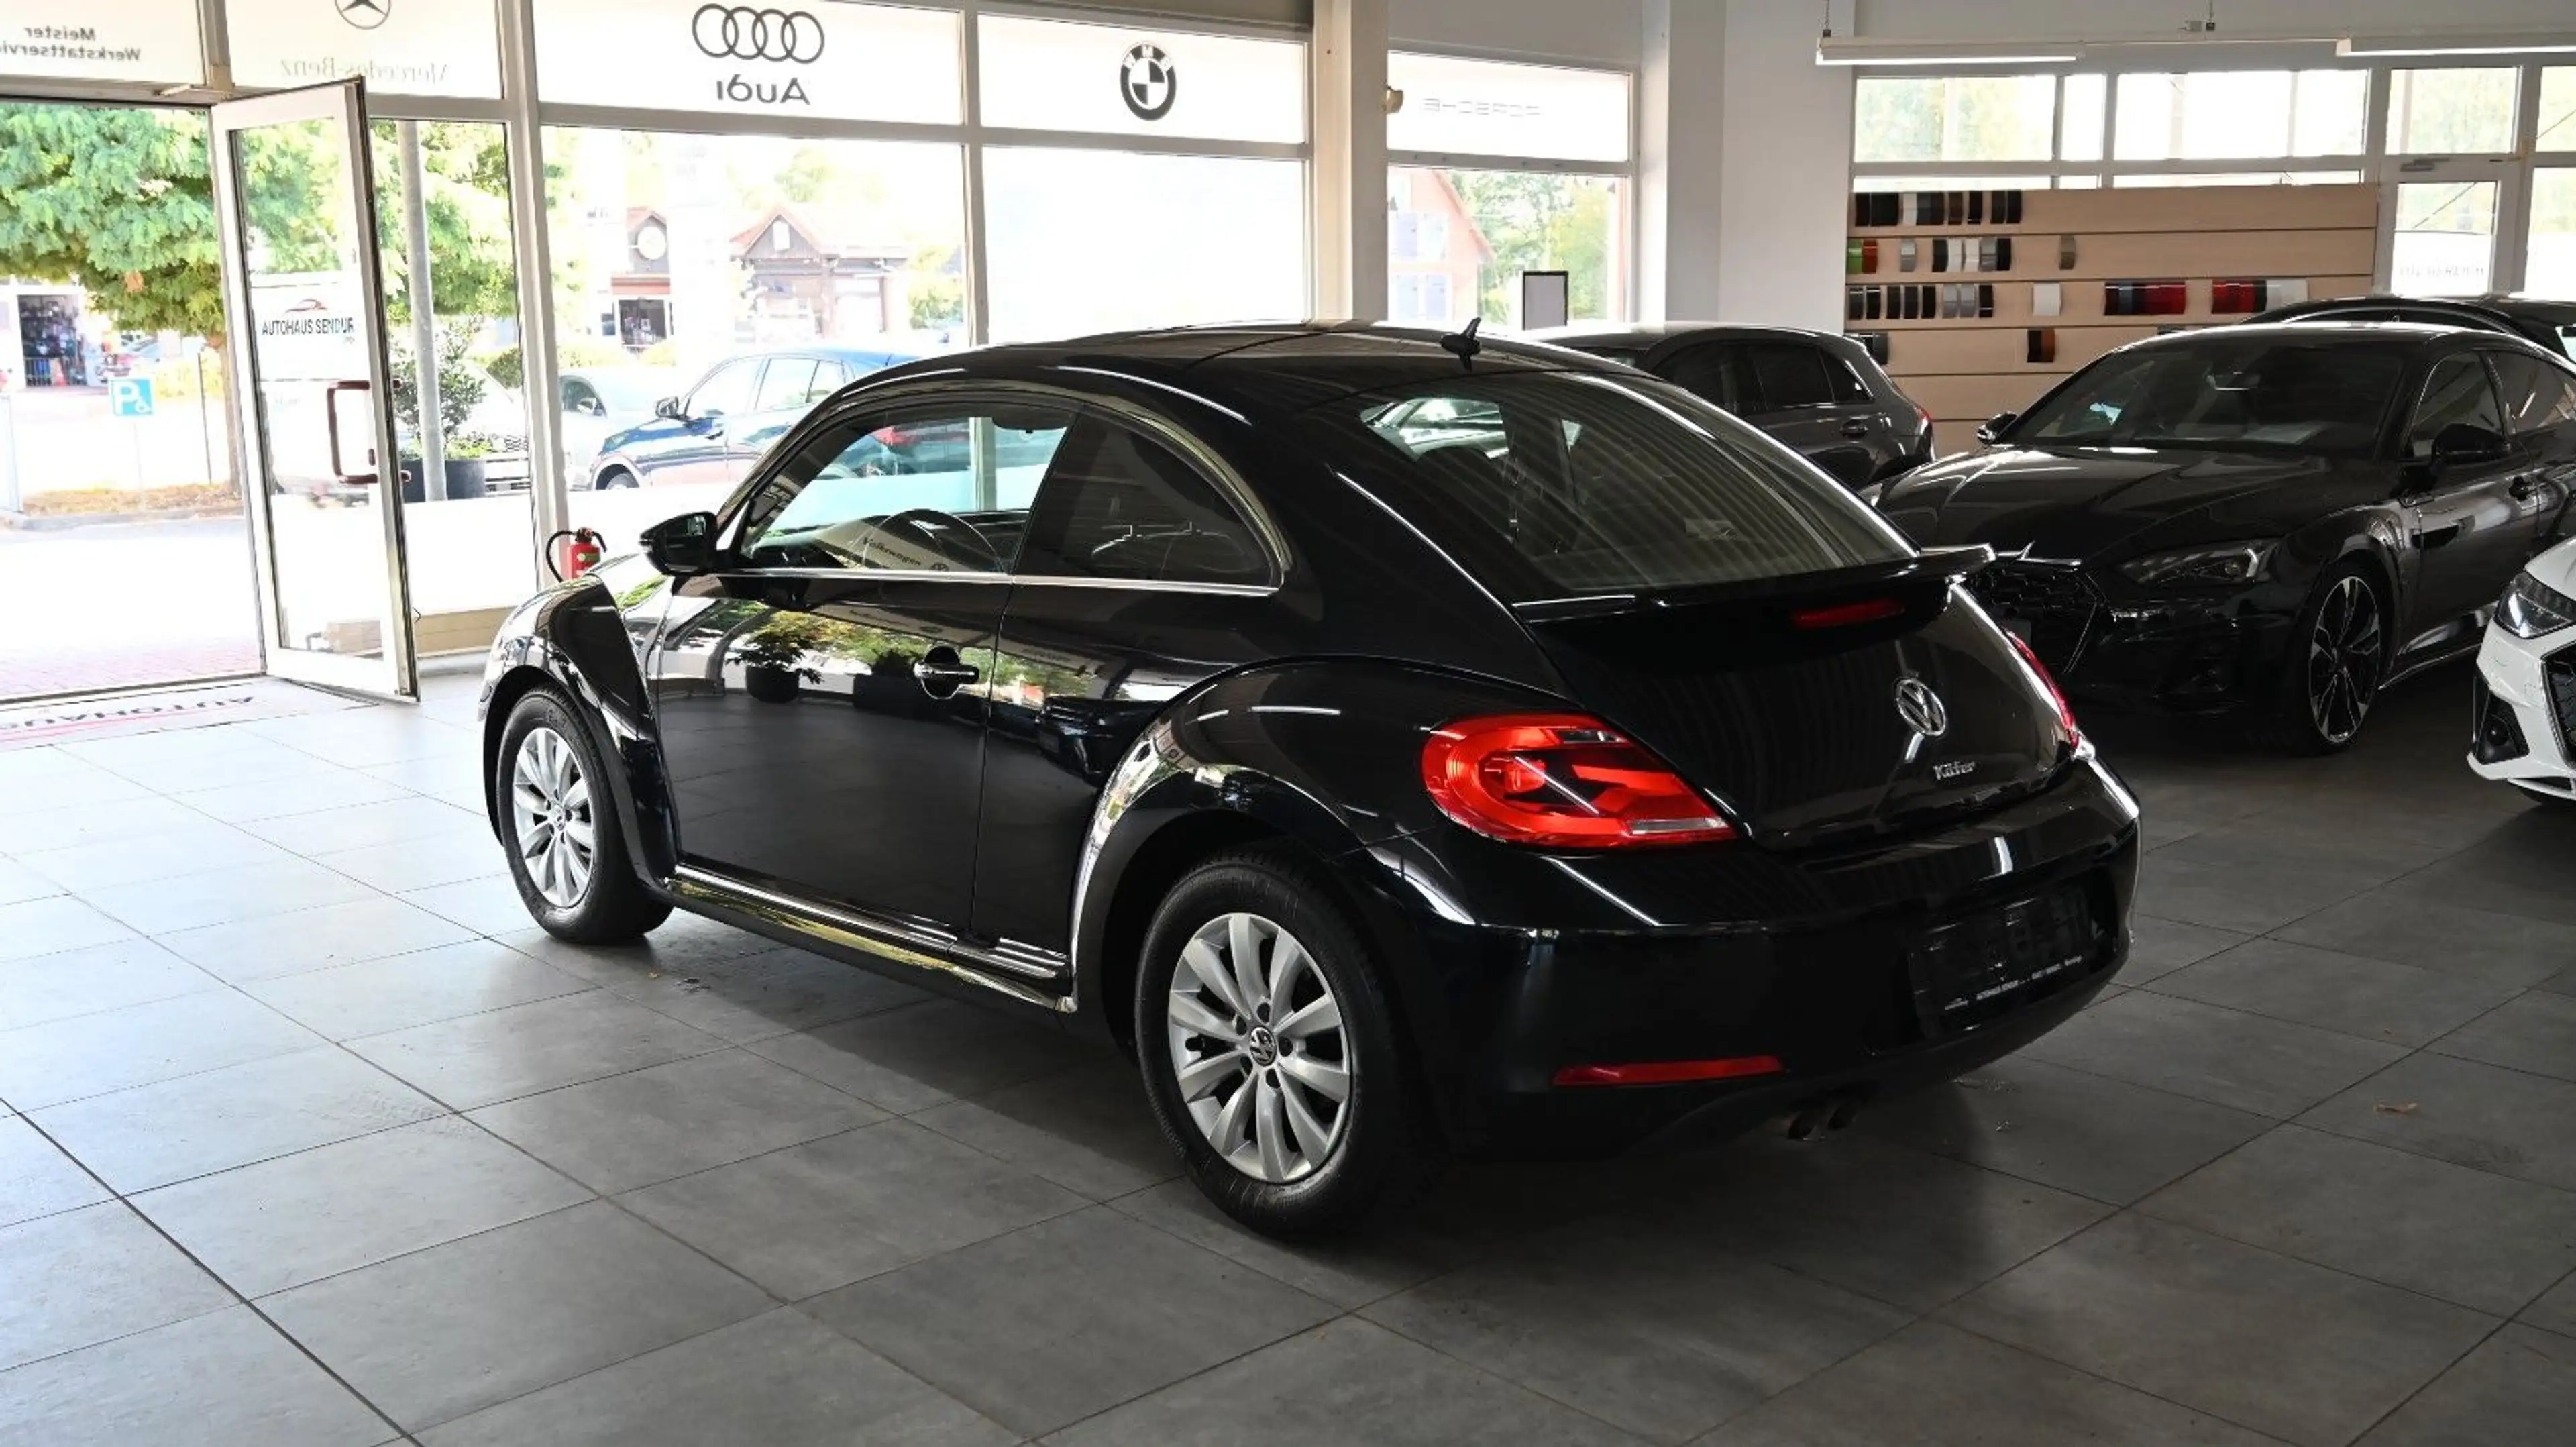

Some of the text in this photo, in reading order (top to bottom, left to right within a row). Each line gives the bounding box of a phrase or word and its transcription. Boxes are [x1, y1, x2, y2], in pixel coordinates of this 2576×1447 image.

[262, 319, 313, 335] AUTOHAUS
[113, 380, 139, 415] P
[1933, 761, 1976, 780] Käfer
